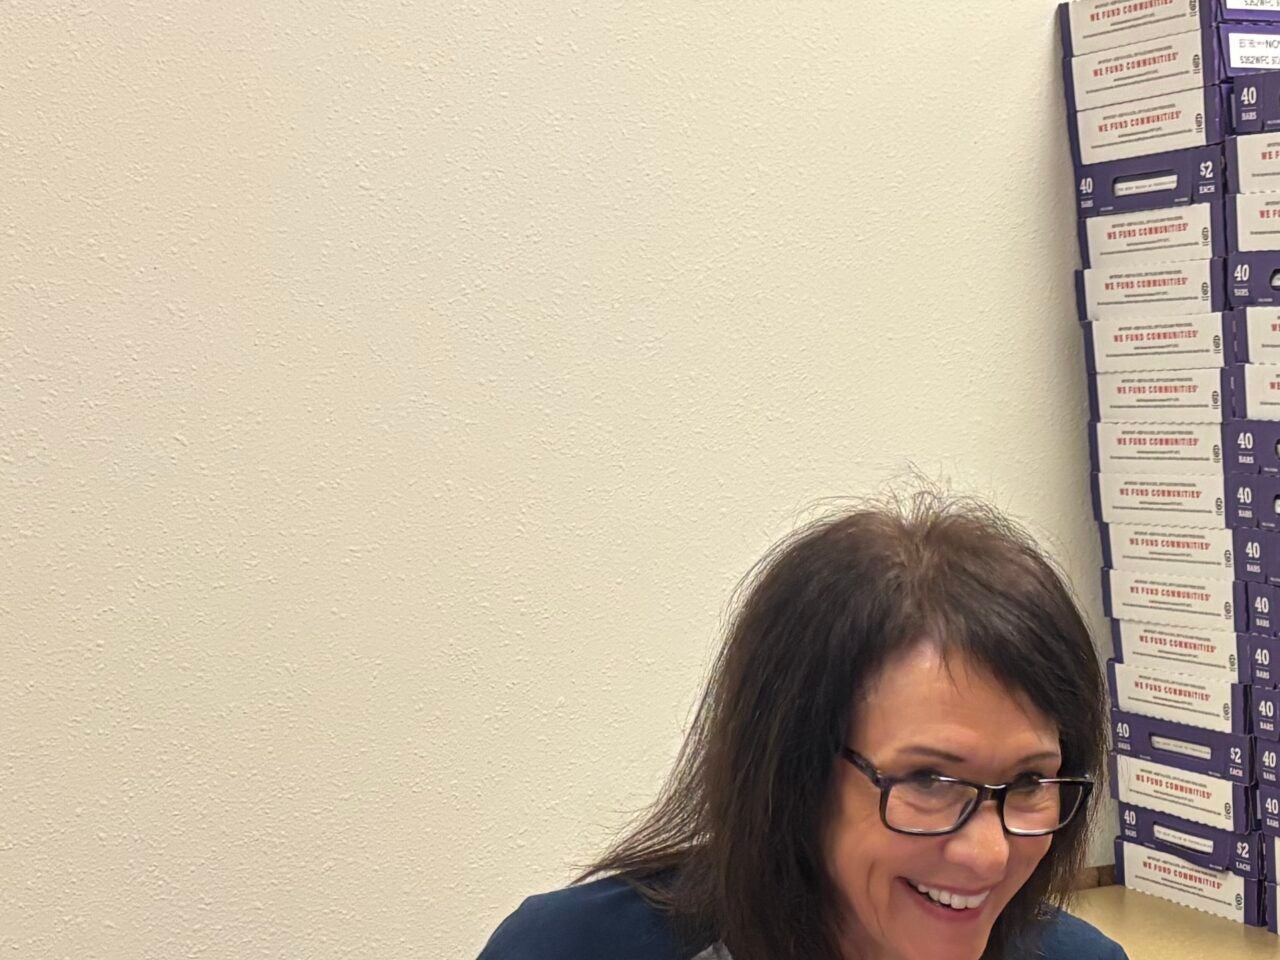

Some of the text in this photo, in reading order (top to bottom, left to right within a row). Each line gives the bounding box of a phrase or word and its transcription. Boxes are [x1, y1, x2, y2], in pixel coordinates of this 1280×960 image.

[1093, 68, 1103, 77] WE
[1105, 64, 1124, 75] FUND
[1241, 87, 1257, 104] 40
[1241, 112, 1257, 120] BARS
[1098, 124, 1108, 133] WE
[1110, 120, 1128, 131] FUND
[1261, 151, 1274, 160] WE
[1200, 161, 1214, 178] $2
[1080, 178, 1093, 194] 40
[1200, 184, 1215, 193] EACH
[1234, 264, 1249, 281] 40
[1234, 288, 1249, 296] BARS
[1237, 433, 1253, 449] 40
[1130, 586, 1140, 594] WE
[1143, 587, 1159, 596] FUND
[1259, 701, 1273, 717] 40
[1265, 798, 1279, 815] 40
[1143, 861, 1152, 869] WE
[1153, 864, 1172, 875] FUND
